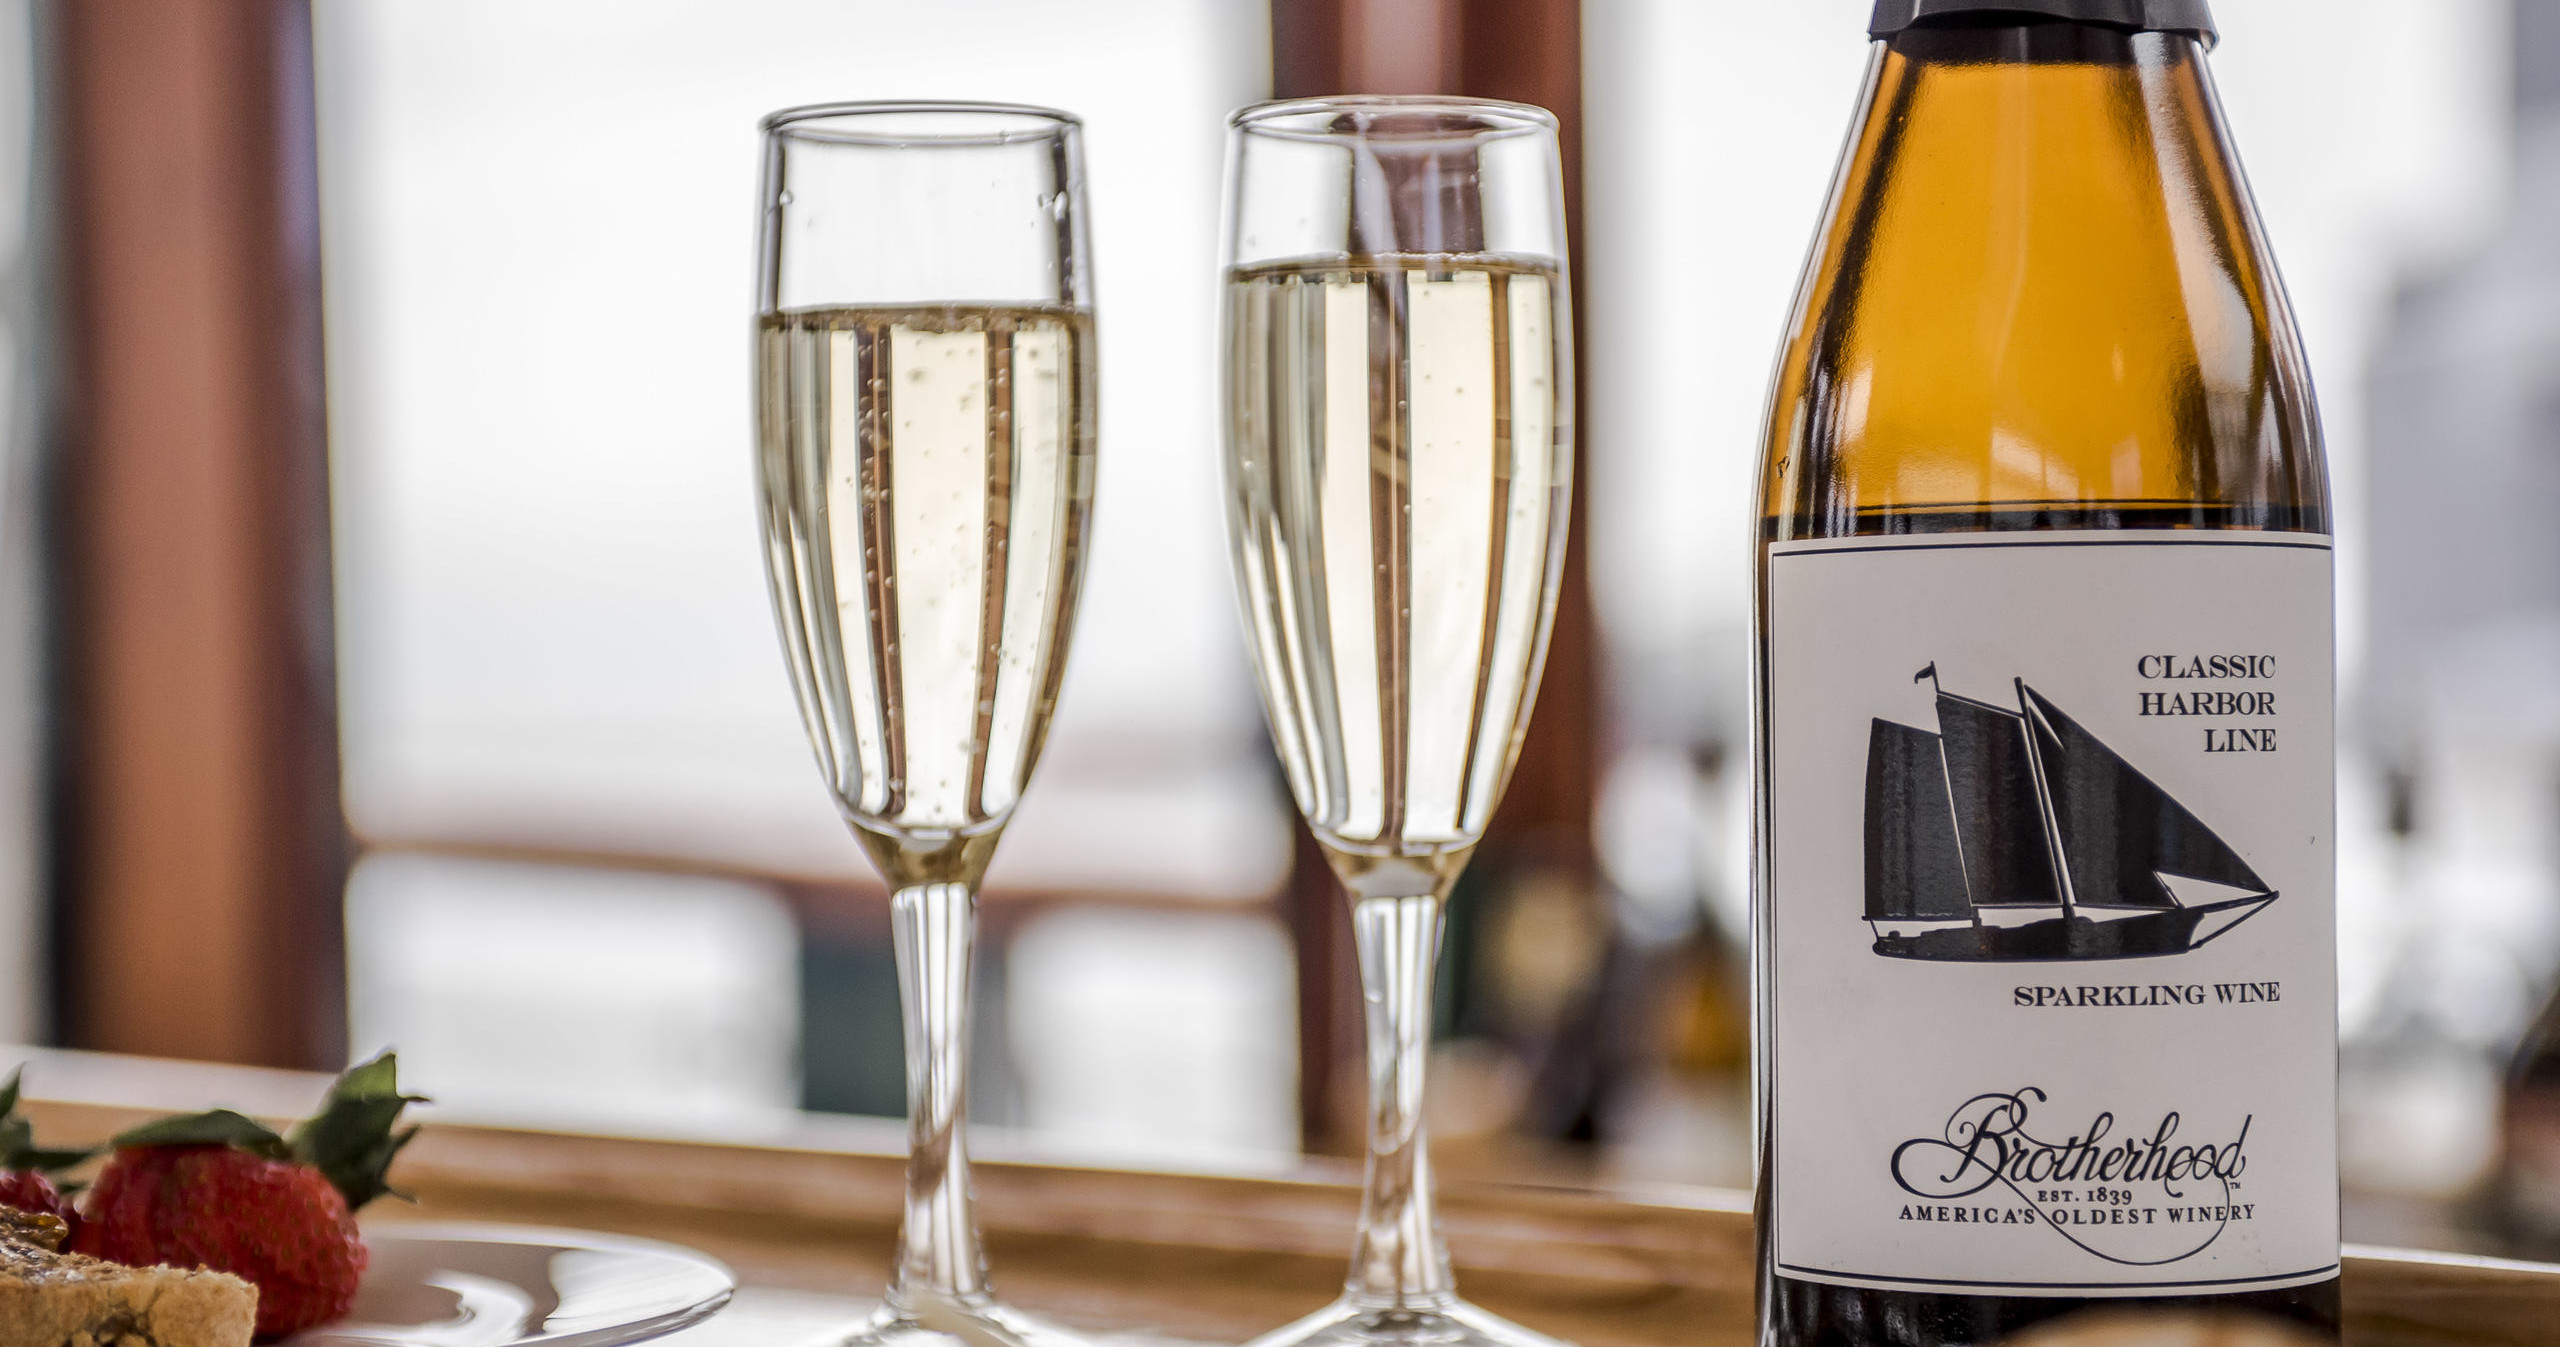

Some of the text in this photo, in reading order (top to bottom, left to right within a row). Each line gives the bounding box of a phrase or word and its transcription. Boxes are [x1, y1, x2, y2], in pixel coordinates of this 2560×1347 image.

[2137, 654, 2276, 679] CLASSIC
[2138, 691, 2276, 716] HARBOR
[2203, 728, 2277, 752] LINE
[2014, 981, 2281, 1007] SPARKLING WINE
[1890, 1086, 2253, 1199] Brotherhood
[2037, 1187, 2133, 1205] EST. 1839
[1899, 1203, 2256, 1226] AMERICA'S OLDEST WINERY
